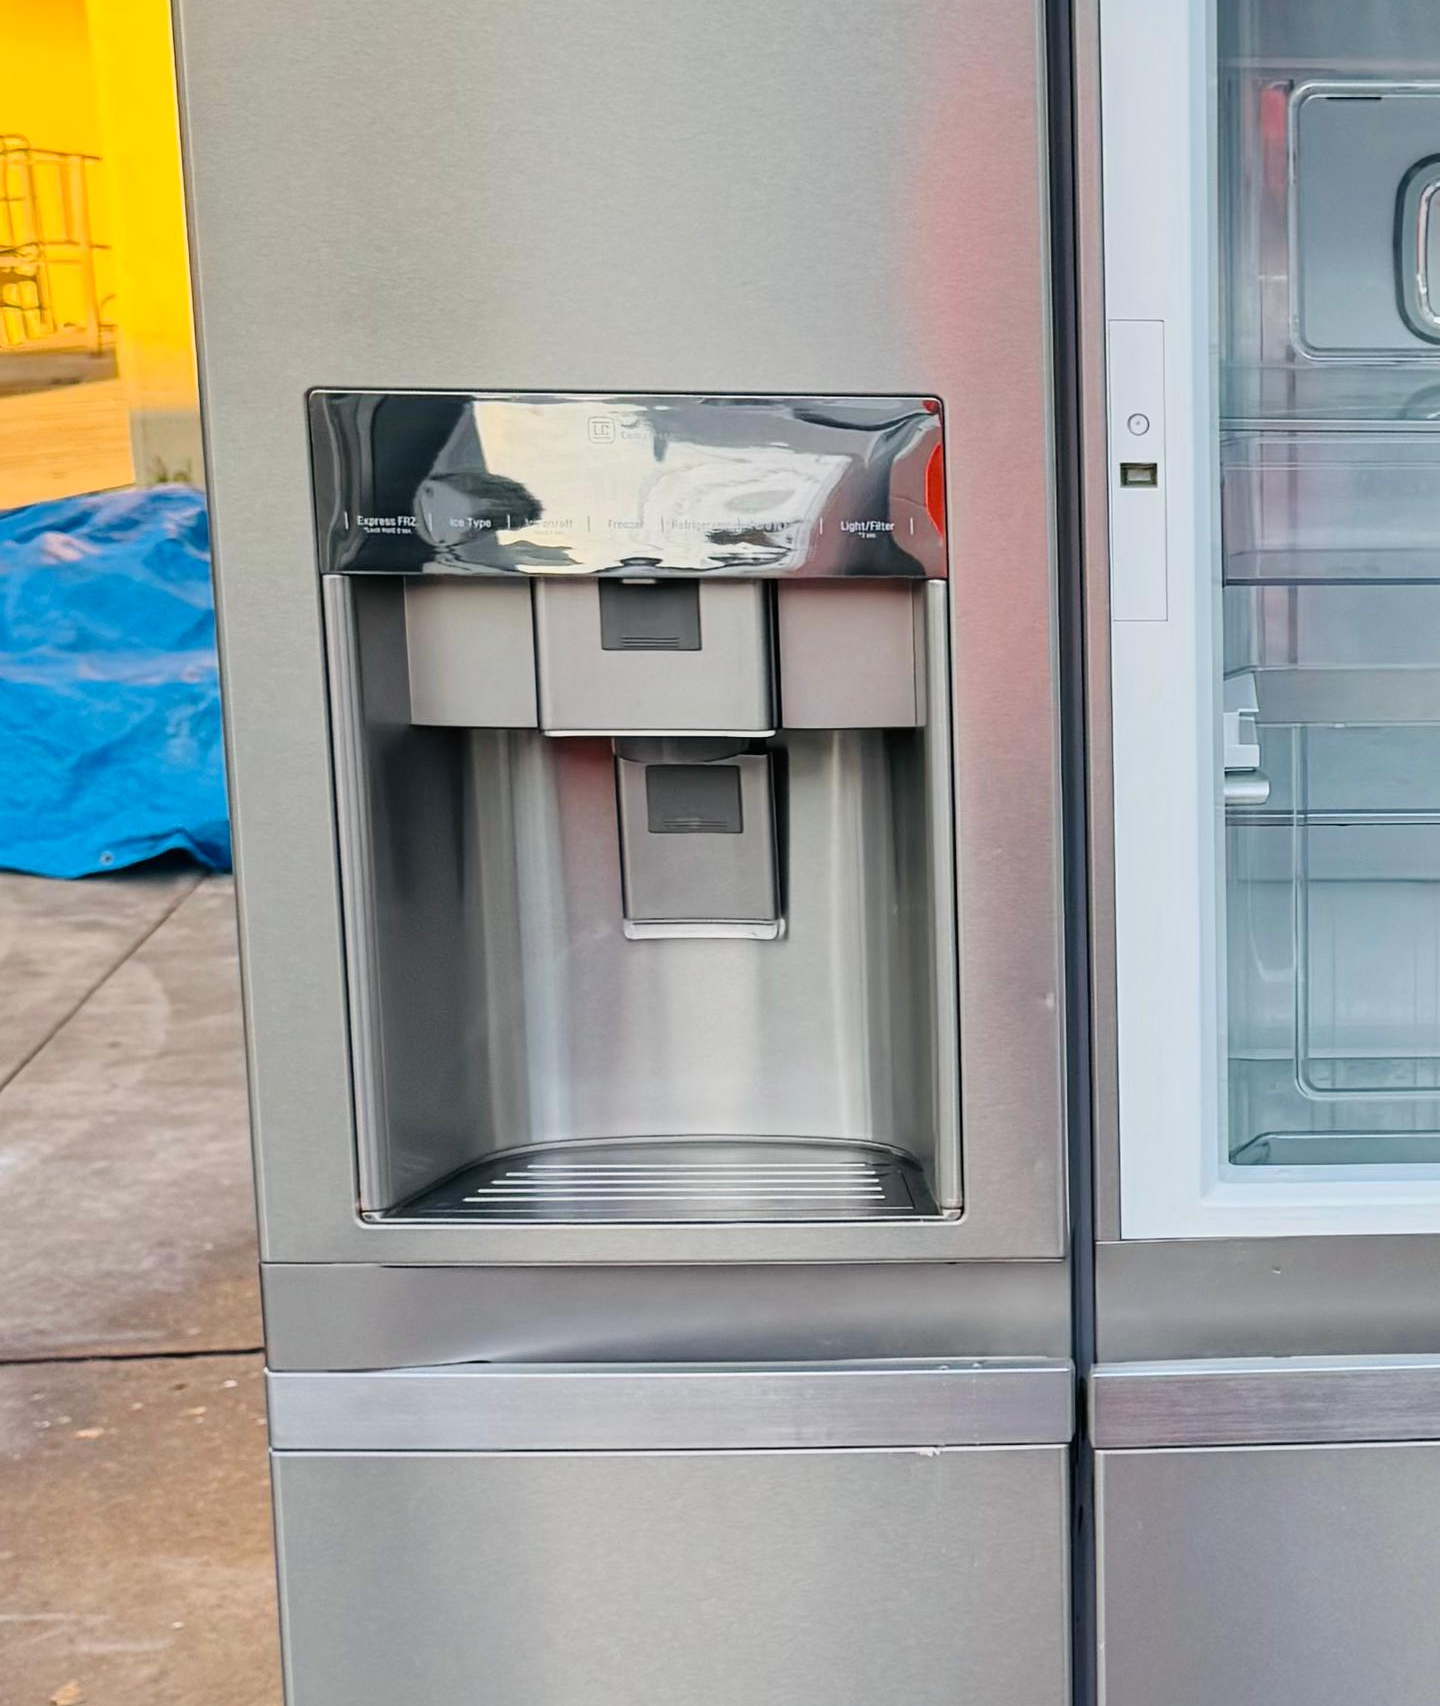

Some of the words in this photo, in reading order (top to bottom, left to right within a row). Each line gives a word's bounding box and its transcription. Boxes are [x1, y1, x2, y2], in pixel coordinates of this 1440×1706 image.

[357, 515, 396, 529] Express
[450, 517, 465, 527] Ice
[468, 518, 492, 530] Type
[840, 520, 895, 534] Light/Filter
